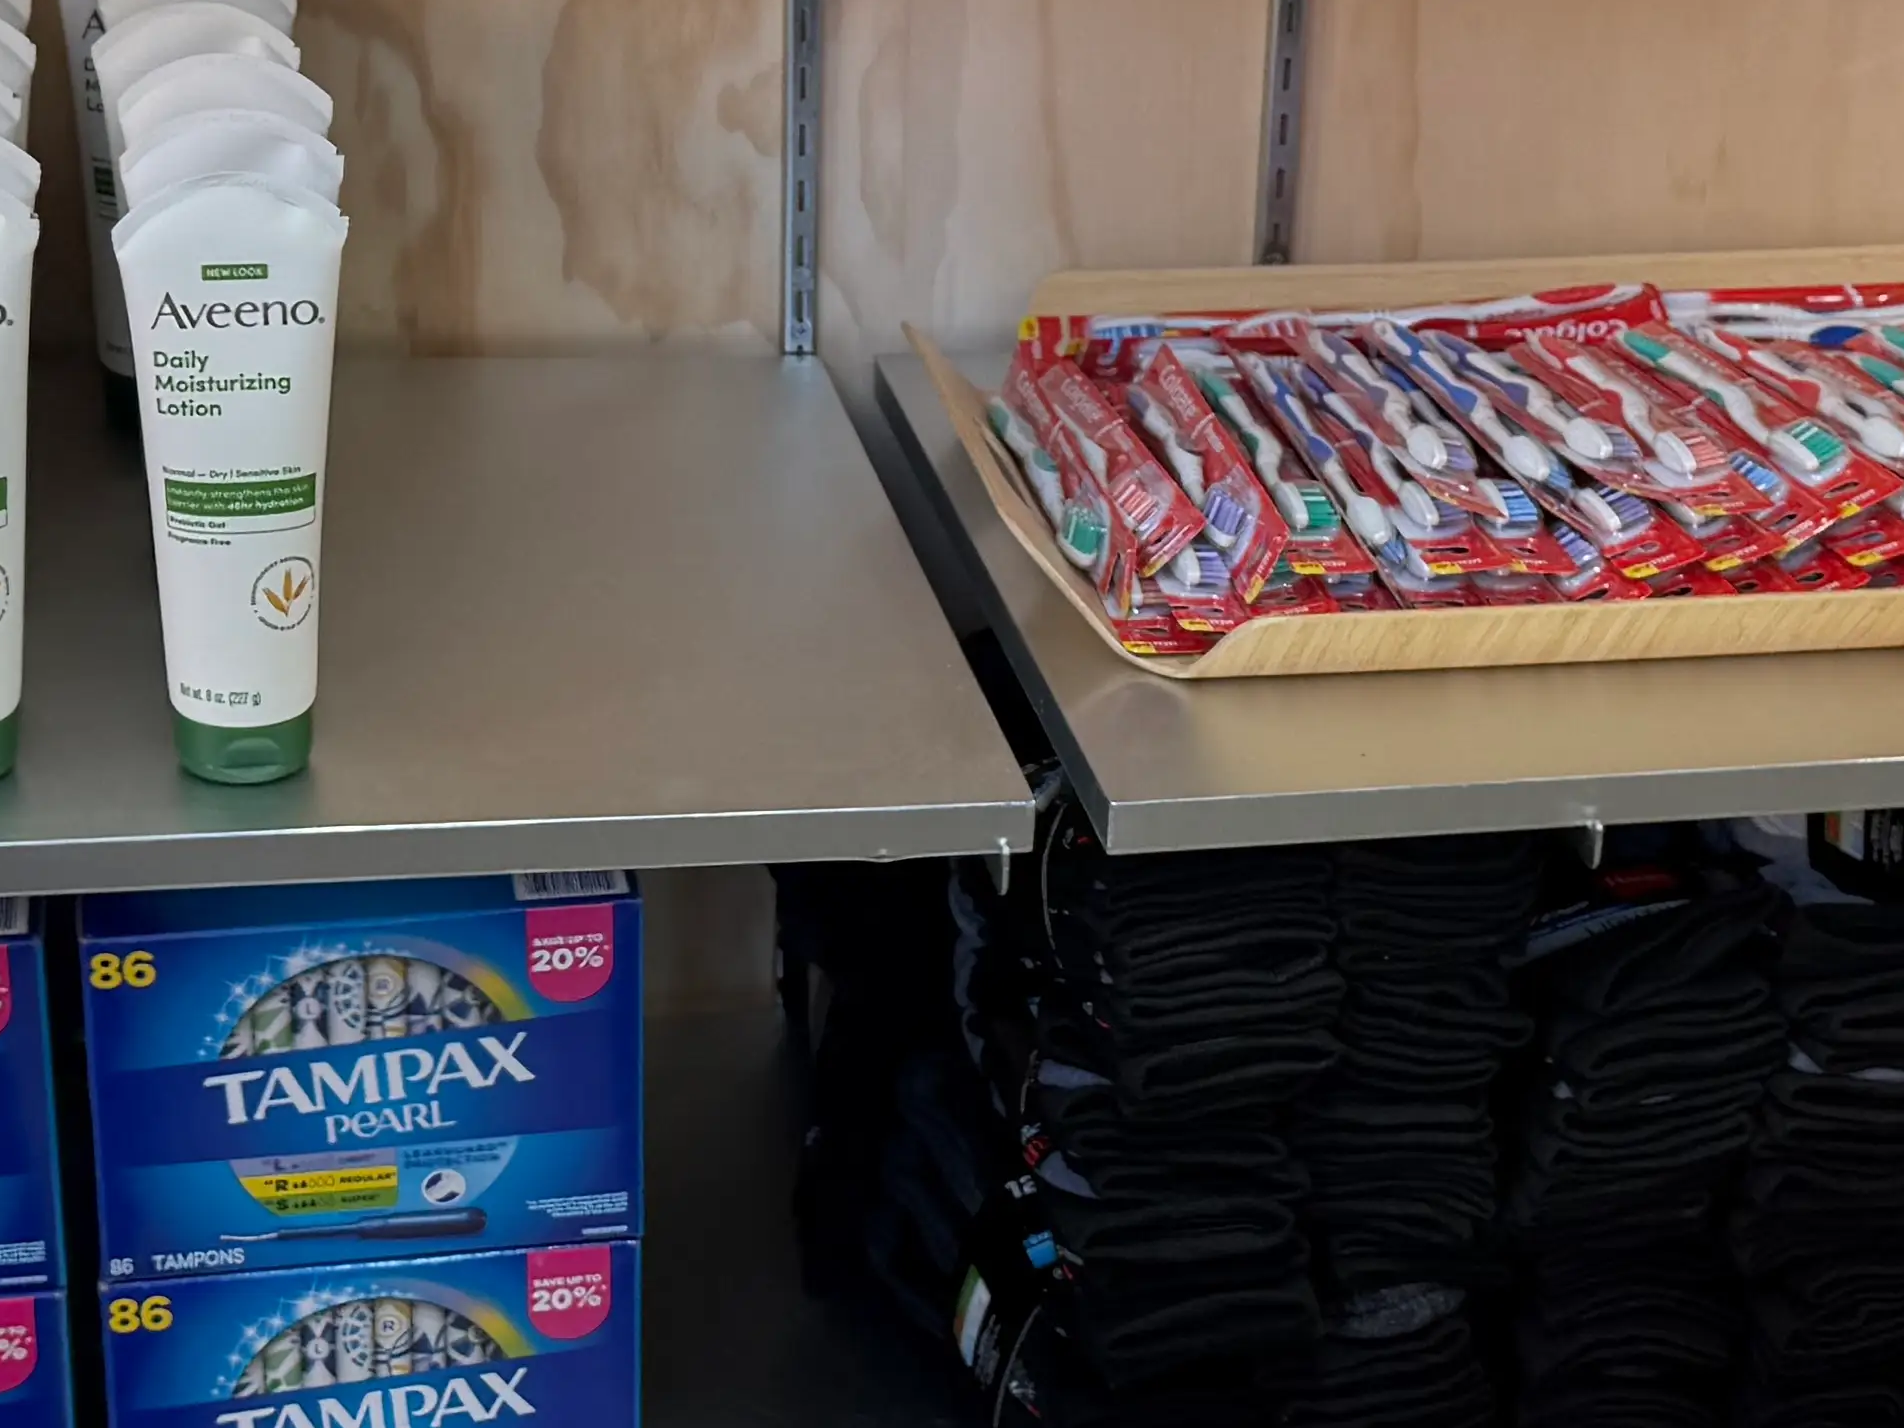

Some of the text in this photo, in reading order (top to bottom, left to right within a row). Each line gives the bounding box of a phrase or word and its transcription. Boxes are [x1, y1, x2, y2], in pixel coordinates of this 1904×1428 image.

[207, 267, 230, 277] NEW
[153, 350, 209, 372] Daily
[155, 373, 291, 394] Moisturizing
[157, 398, 222, 416] Lotion
[255, 497, 304, 510] hydration
[90, 951, 156, 989] 86
[204, 1032, 536, 1124] TAMPAX
[111, 1248, 245, 1275] 86 TAMPONS
[533, 1274, 602, 1287] SAVE UP TO
[108, 1296, 173, 1333] 86
